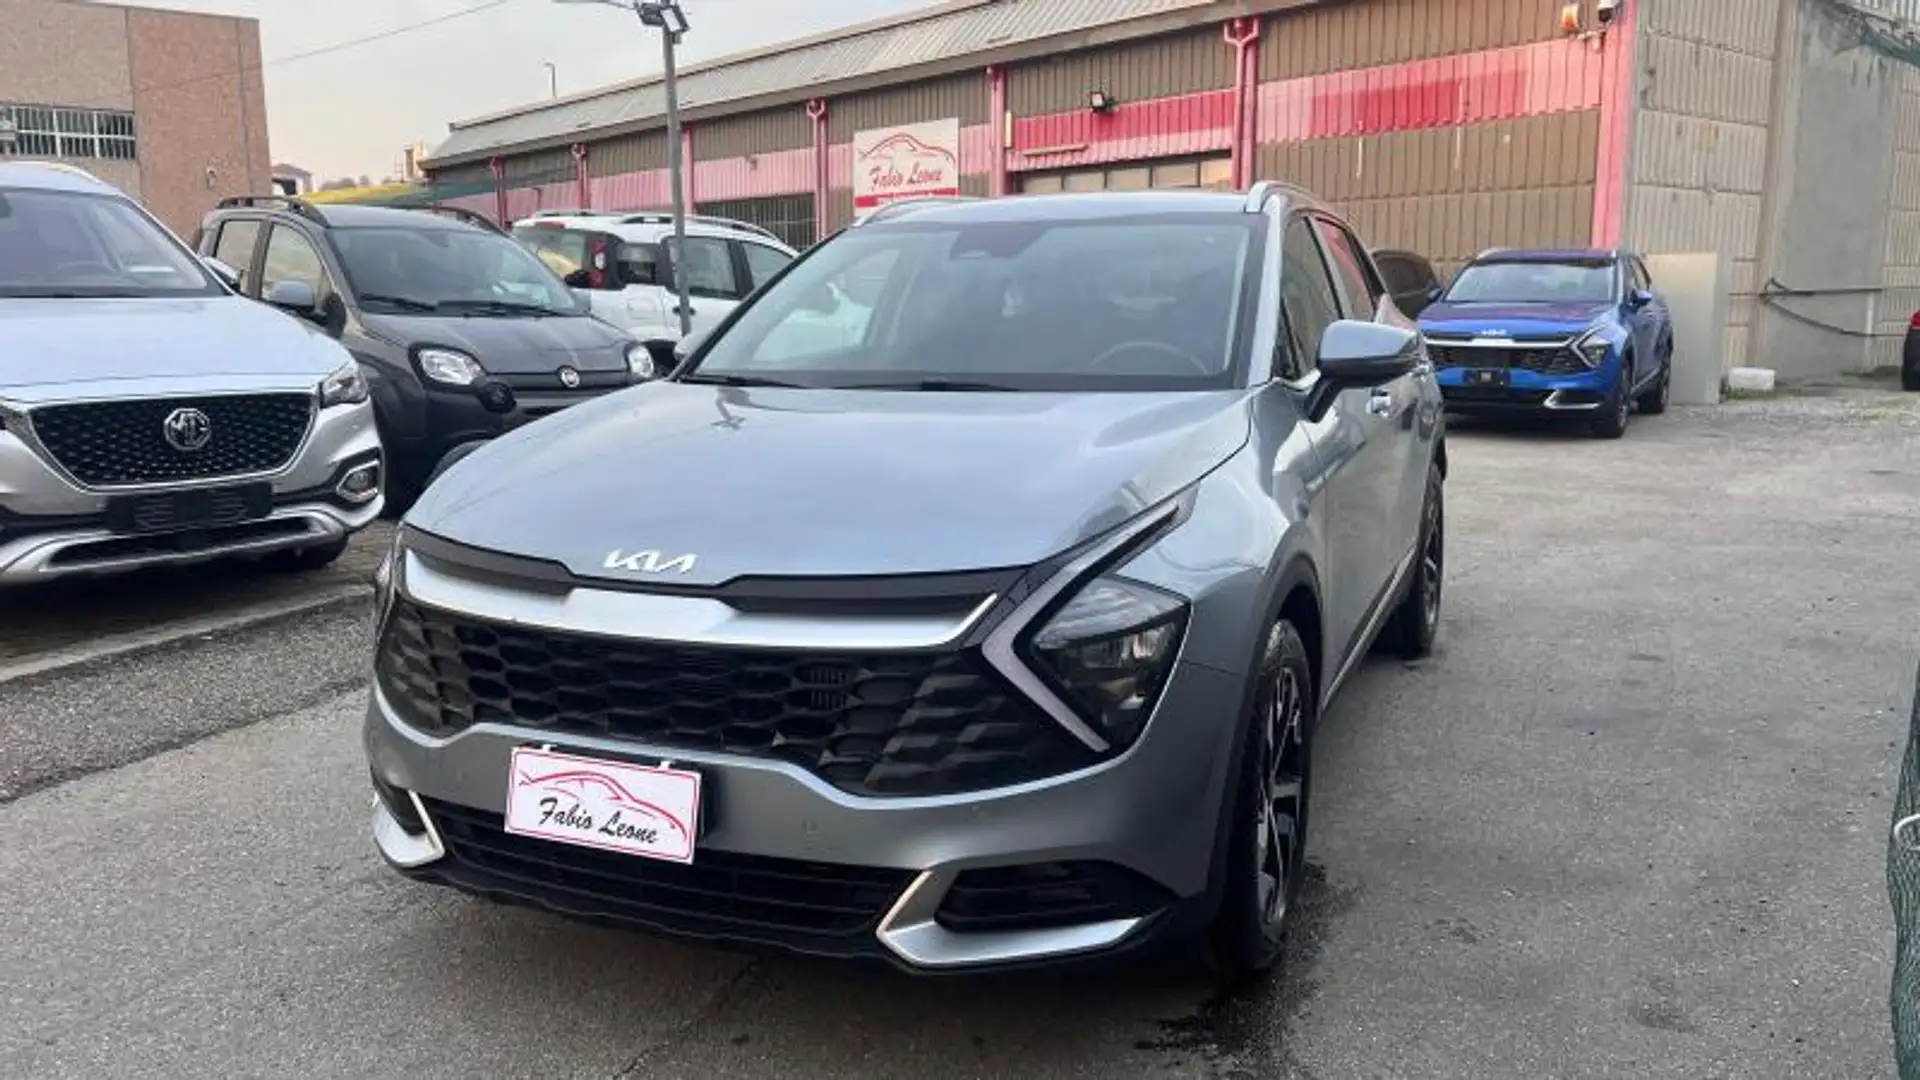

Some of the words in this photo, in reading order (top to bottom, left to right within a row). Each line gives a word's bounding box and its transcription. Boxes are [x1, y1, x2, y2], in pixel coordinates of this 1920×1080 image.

[168, 411, 209, 447] MG
[539, 797, 593, 830] Fabio
[598, 811, 660, 844] Leone
